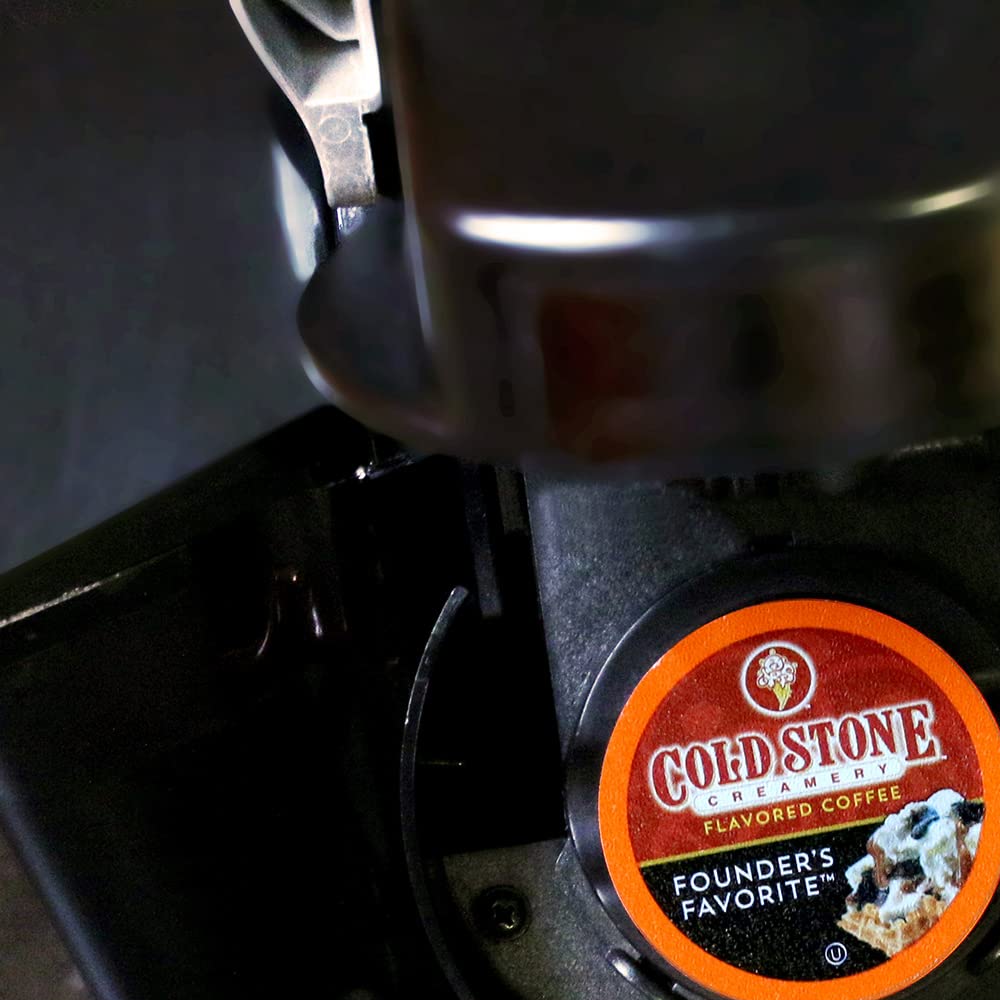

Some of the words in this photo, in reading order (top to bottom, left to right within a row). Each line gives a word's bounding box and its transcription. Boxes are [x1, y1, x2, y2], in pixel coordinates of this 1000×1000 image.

[652, 734, 772, 807] COLD
[781, 703, 936, 773] STONE
[703, 802, 813, 835] FLAVORED
[821, 785, 901, 813] COFFEE
[707, 763, 888, 807] CREAMERY
[673, 847, 834, 897] FOUNDER'S
